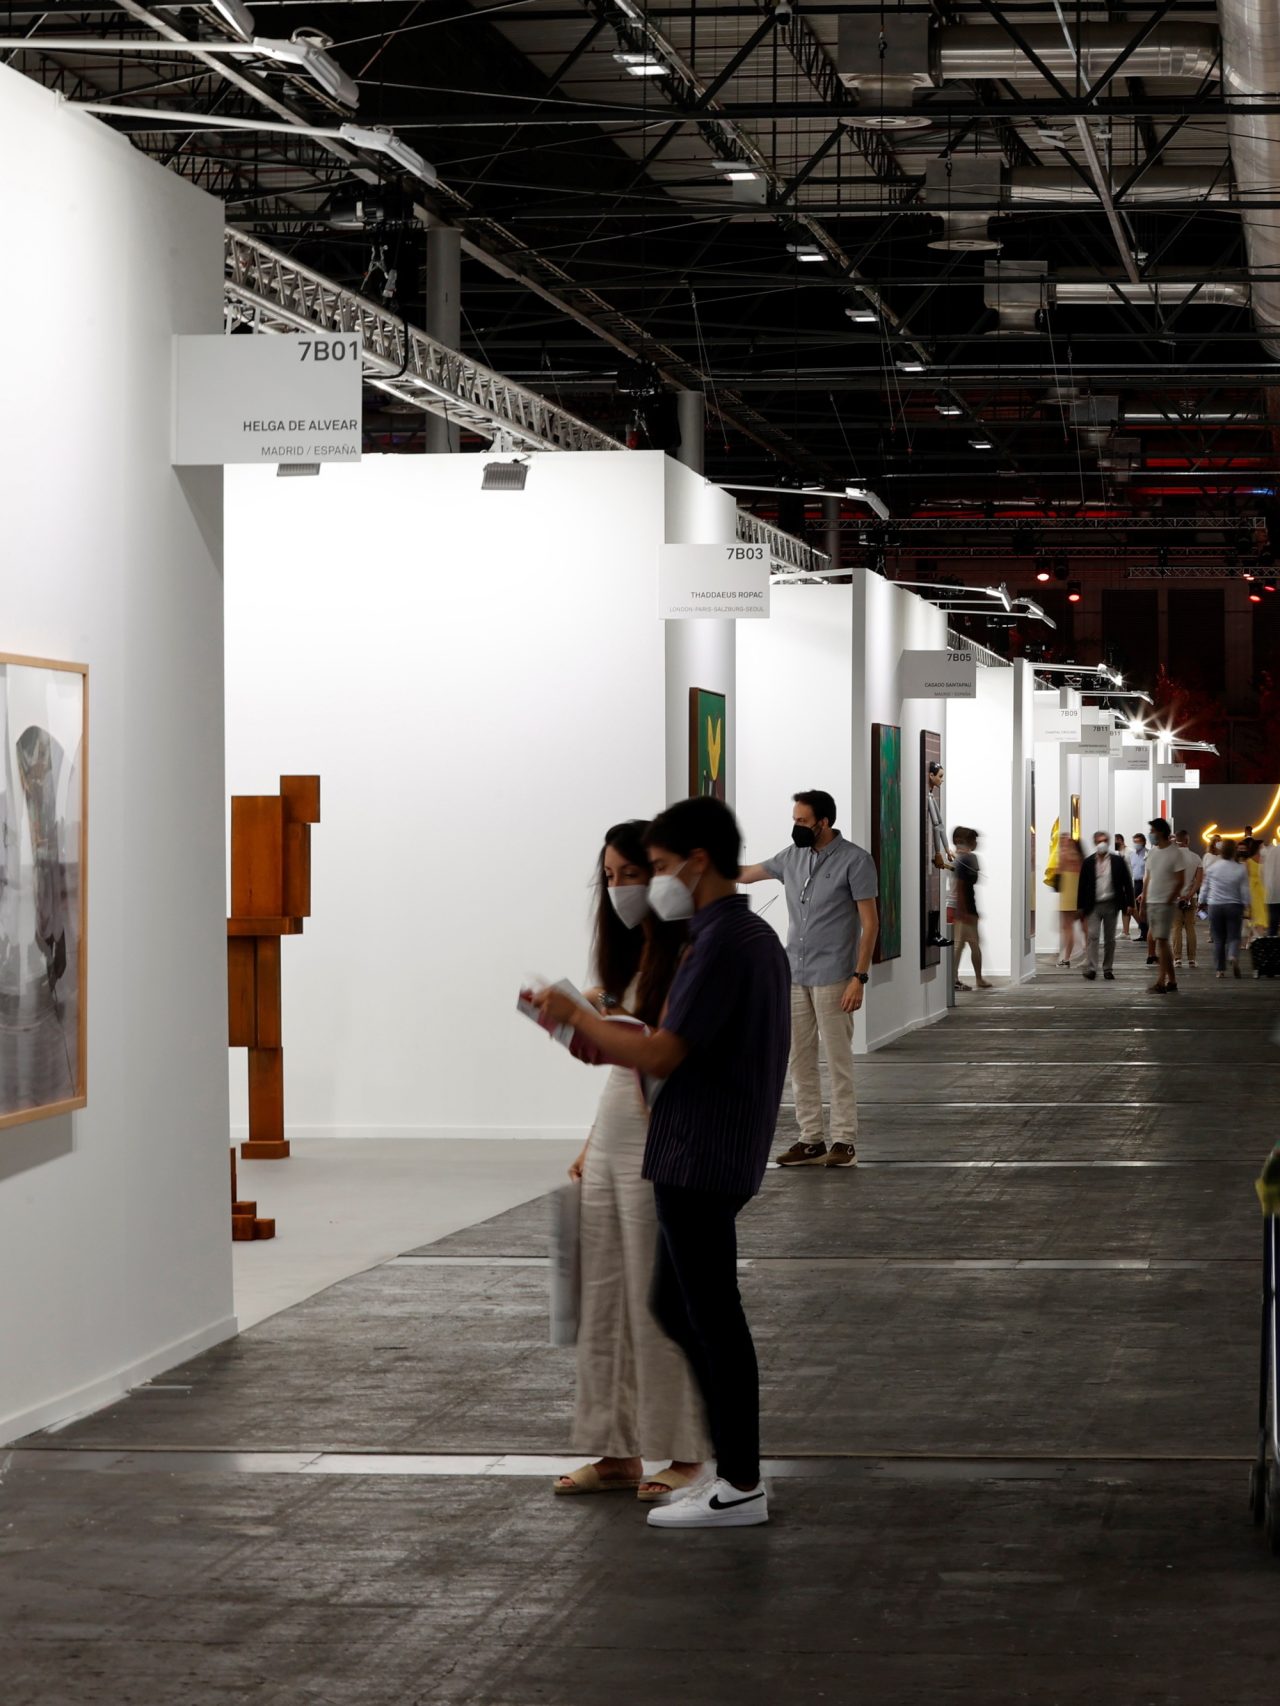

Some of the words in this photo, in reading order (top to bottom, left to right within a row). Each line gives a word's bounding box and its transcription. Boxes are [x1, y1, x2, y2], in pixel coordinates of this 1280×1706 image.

[298, 340, 358, 362] 7B01
[243, 420, 285, 432] HELGA
[288, 420, 306, 431] DE
[308, 419, 358, 431] ALVEAR
[261, 446, 304, 456] MADRID
[314, 444, 357, 456] ESPAÑA
[726, 548, 764, 560] 7B03
[691, 591, 737, 599] THADDAEUS
[738, 591, 764, 599] ROPAC
[947, 653, 971, 661] 7B05
